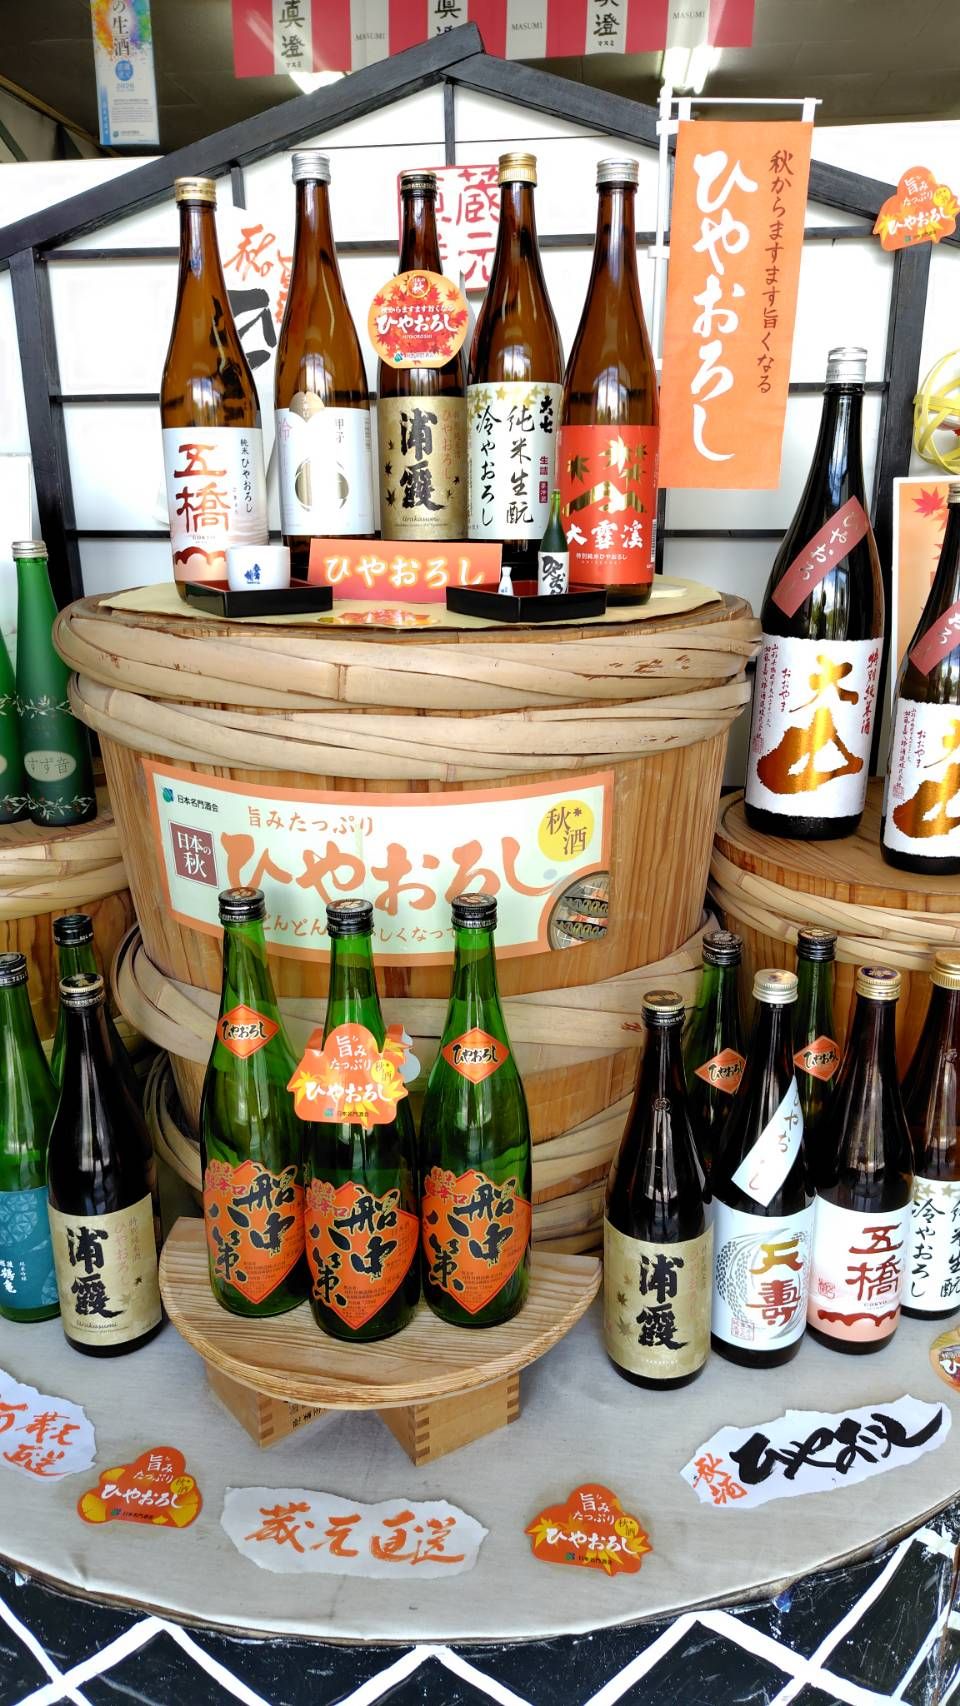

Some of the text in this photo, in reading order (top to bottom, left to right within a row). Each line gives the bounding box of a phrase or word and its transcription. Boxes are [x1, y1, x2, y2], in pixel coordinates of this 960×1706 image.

[511, 22, 543, 31] MASUMI
[593, 0, 620, 37] 澄
[672, 11, 705, 20] MASUMI
[888, 206, 952, 236] ひやおろし
[756, 150, 794, 395] 秋からますます旨くなる
[690, 150, 758, 462] ひやおろし
[376, 313, 459, 335] ひやおろし
[539, 395, 553, 434] 大七
[400, 407, 447, 512] 浦霞
[475, 404, 502, 527] 冷やおろし
[173, 443, 231, 533] 五橋
[324, 555, 483, 588] ひやおろし
[177, 794, 219, 813] 日本名門酒会
[247, 805, 374, 837] 旨みたっぷり
[177, 831, 212, 856] 日本の
[184, 851, 207, 878] 秋
[220, 831, 561, 917] ひやおろし
[221, 1020, 267, 1041] ひやおろし
[336, 1035, 368, 1058] 旨み
[452, 1043, 498, 1065] ひやおろし
[803, 1047, 838, 1069] ひやおろし
[329, 1058, 371, 1071] たっぷり
[708, 1060, 743, 1083] ひやおろし
[305, 1081, 393, 1104] ひやおろし
[911, 1198, 945, 1298] 冷やおろし
[66, 1226, 125, 1319] 浦霞
[845, 1223, 904, 1301] 五橋
[636, 1252, 690, 1350] 浦霞
[148, 1454, 173, 1472] 旨み
[101, 1484, 183, 1509] ひやおろし
[580, 1492, 610, 1512] 旨み
[572, 1510, 615, 1526] たっぷり
[546, 1527, 637, 1555] ひやおろし
